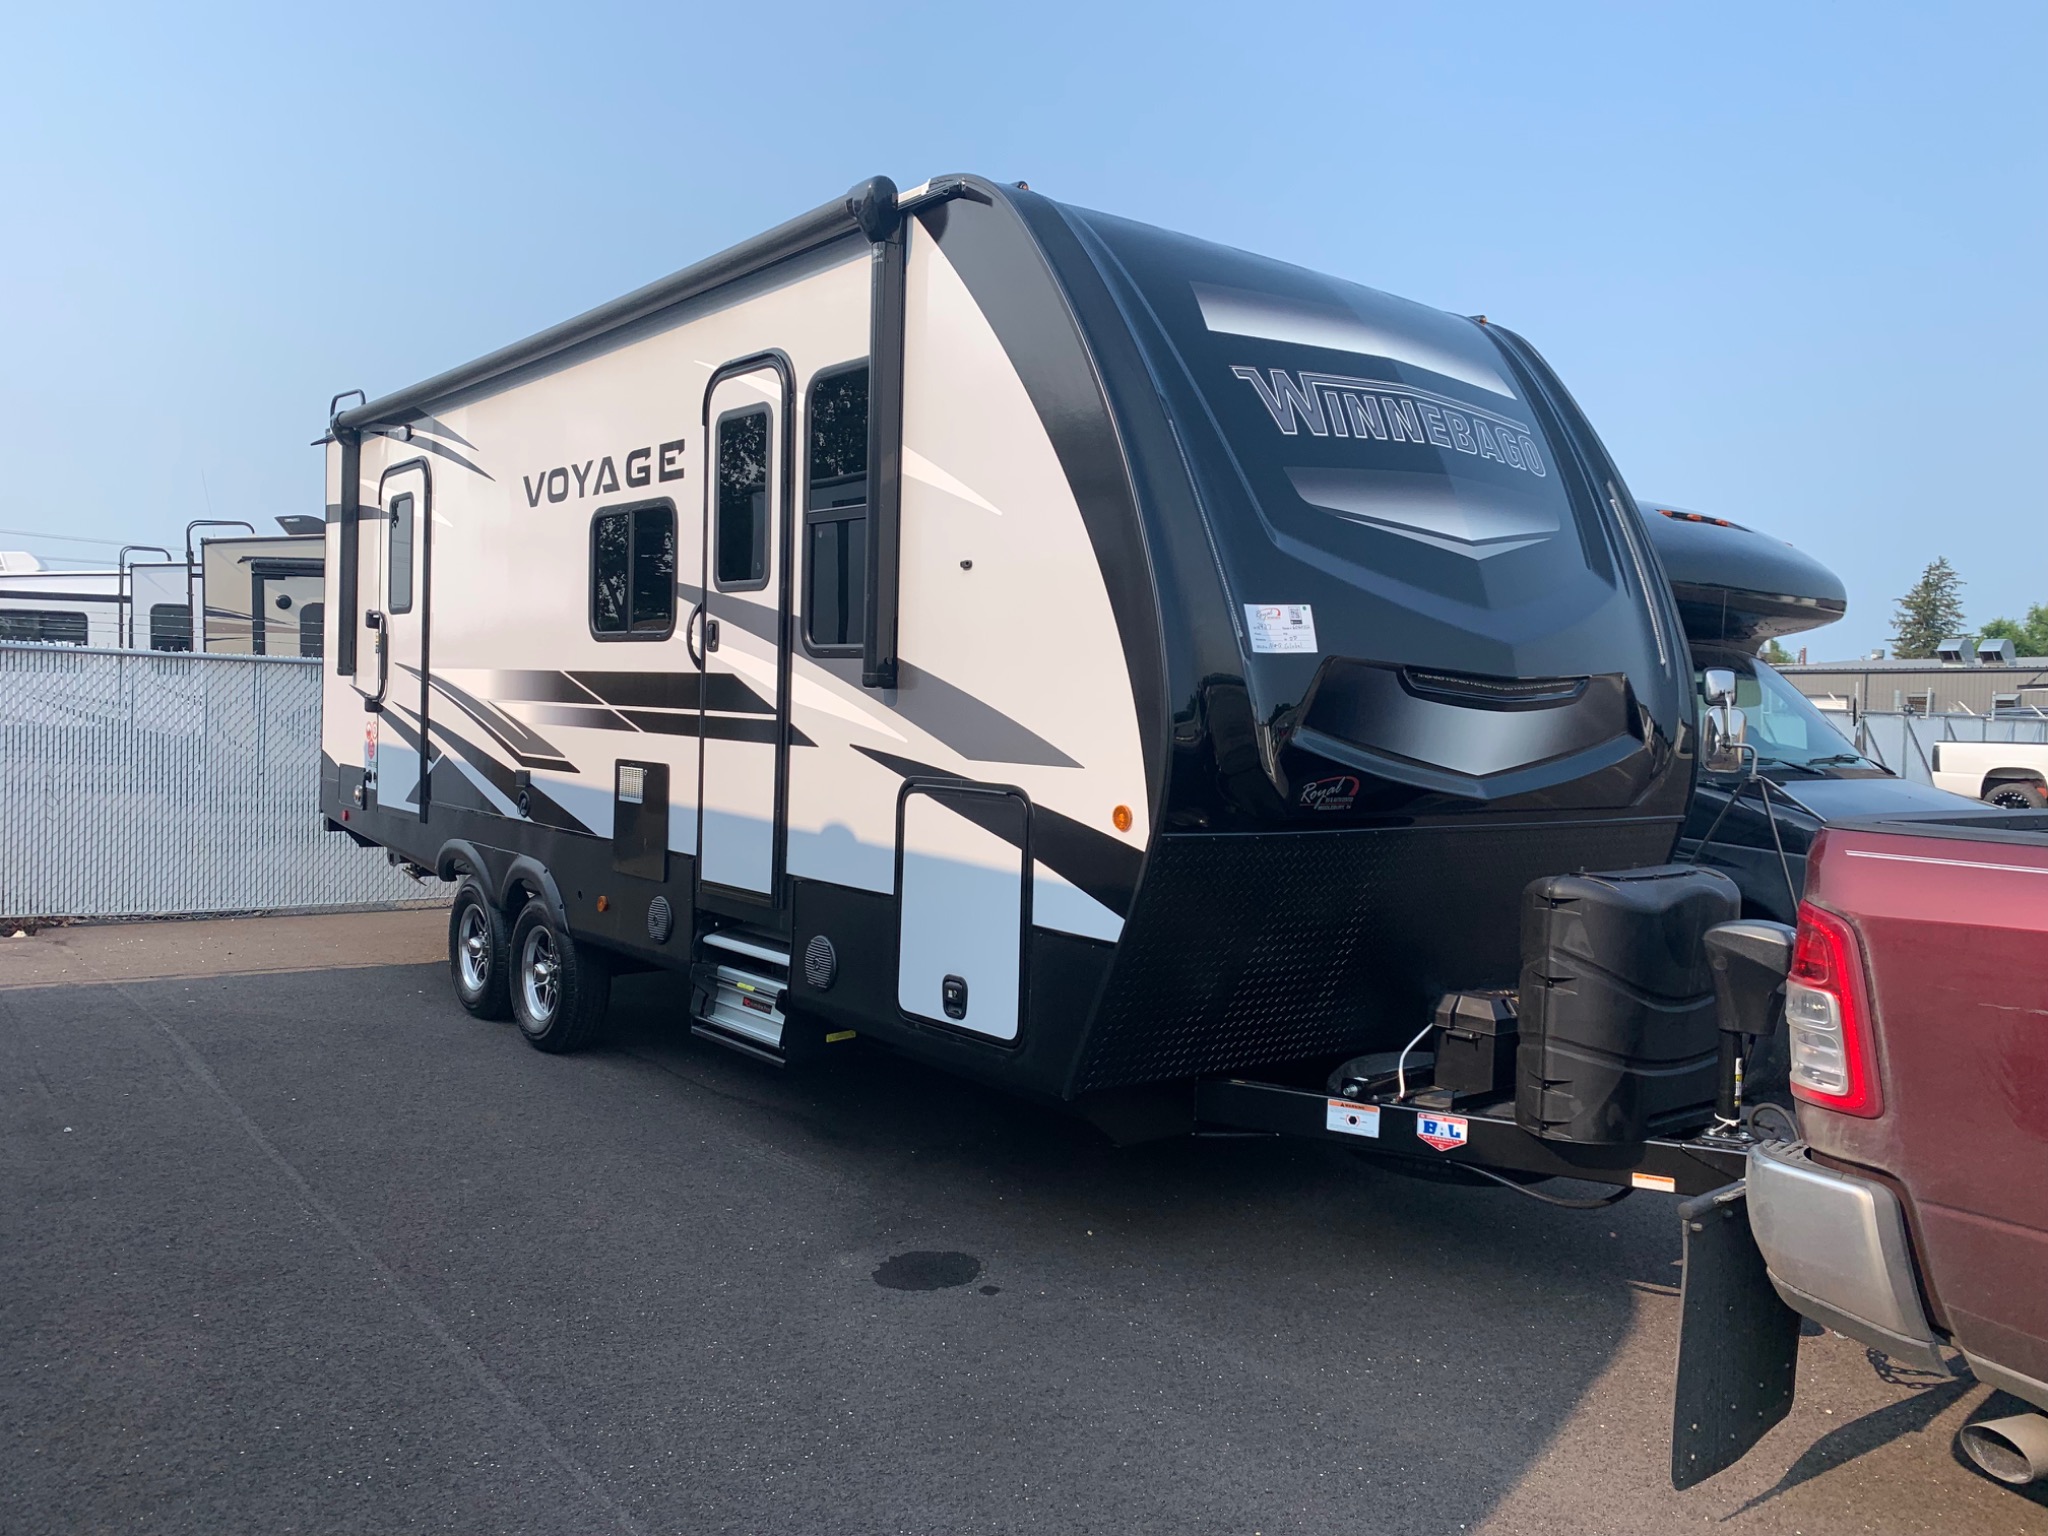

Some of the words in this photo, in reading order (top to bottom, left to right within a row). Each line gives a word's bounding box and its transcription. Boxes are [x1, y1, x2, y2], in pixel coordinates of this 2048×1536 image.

[1228, 364, 1546, 477] WINNEBAGO
[523, 439, 685, 508] VOYAGE
[1300, 776, 1345, 809] Royal
